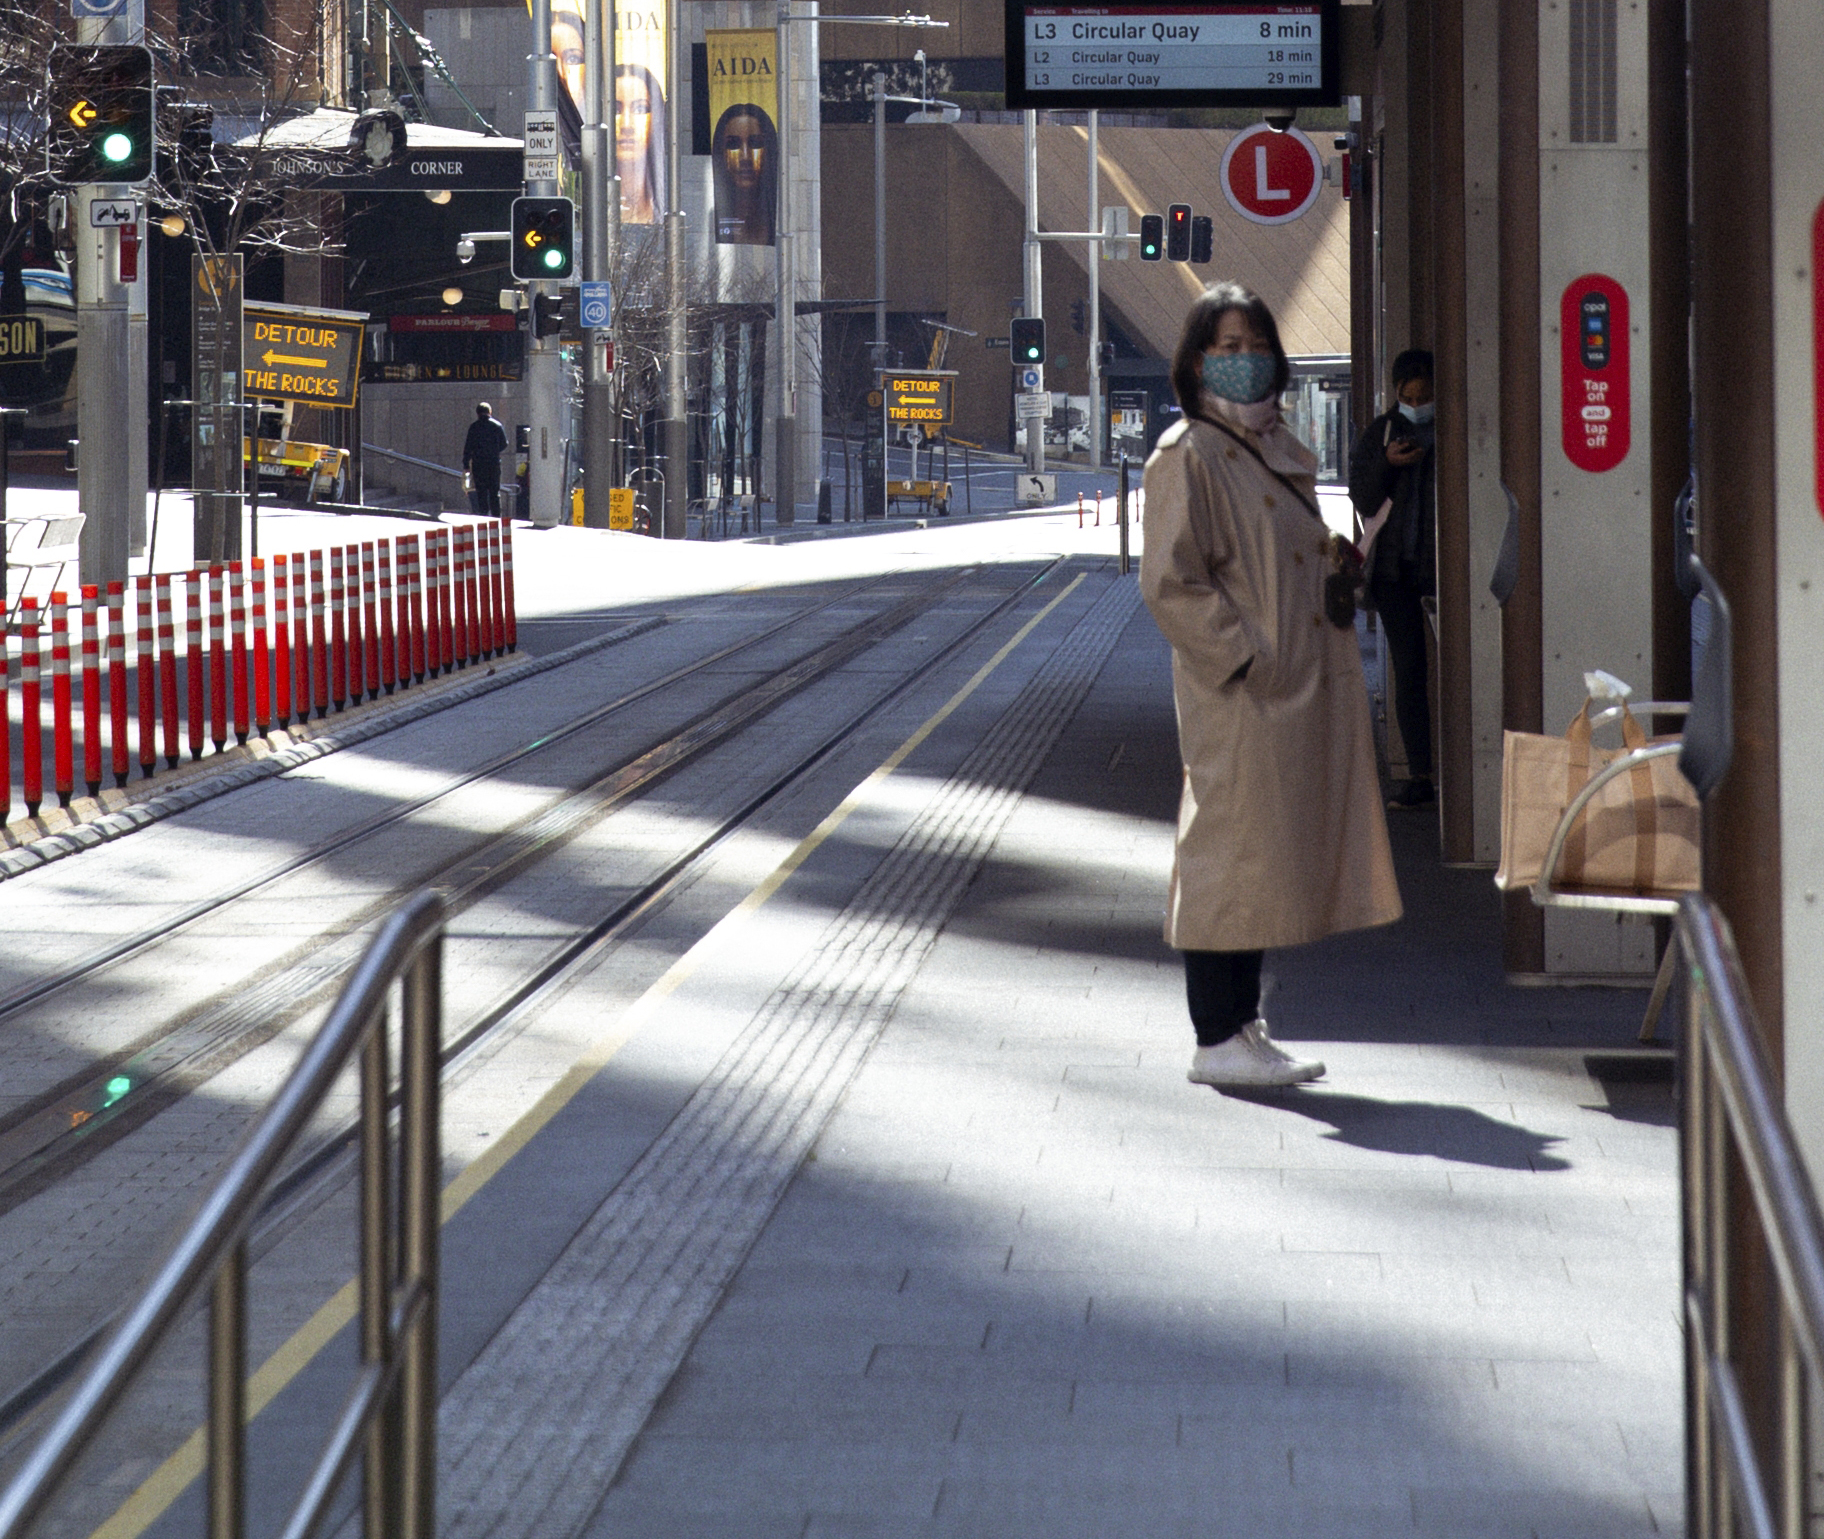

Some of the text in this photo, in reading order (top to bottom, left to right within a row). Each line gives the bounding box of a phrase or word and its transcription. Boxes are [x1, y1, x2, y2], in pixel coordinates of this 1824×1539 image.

[1034, 21, 1313, 43] L3 Circular Quay 8 min
[1034, 50, 1313, 66] L2 Circular Quay 18 min
[713, 56, 772, 77] AIDA
[1034, 72, 1313, 88] L3 Circular Quay 29 min
[529, 138, 554, 150] ONLY
[272, 161, 464, 176] JOHNSON'S CORNER
[528, 161, 554, 169] RIGHT
[528, 170, 555, 178] LANE
[1255, 145, 1291, 201] L
[587, 306, 604, 318] 40
[1583, 302, 1606, 312] opal
[414, 318, 461, 327] PARLOUR
[254, 322, 339, 349] DETOUR
[244, 369, 340, 398] THE ROCKS
[893, 380, 941, 393] DETOUR
[1583, 379, 1608, 393] Tap
[1587, 393, 1605, 401] on
[889, 407, 943, 420] THE ROCKS
[1586, 409, 1605, 417] and
[1584, 423, 1608, 434] tap
[1586, 436, 1607, 447] off
